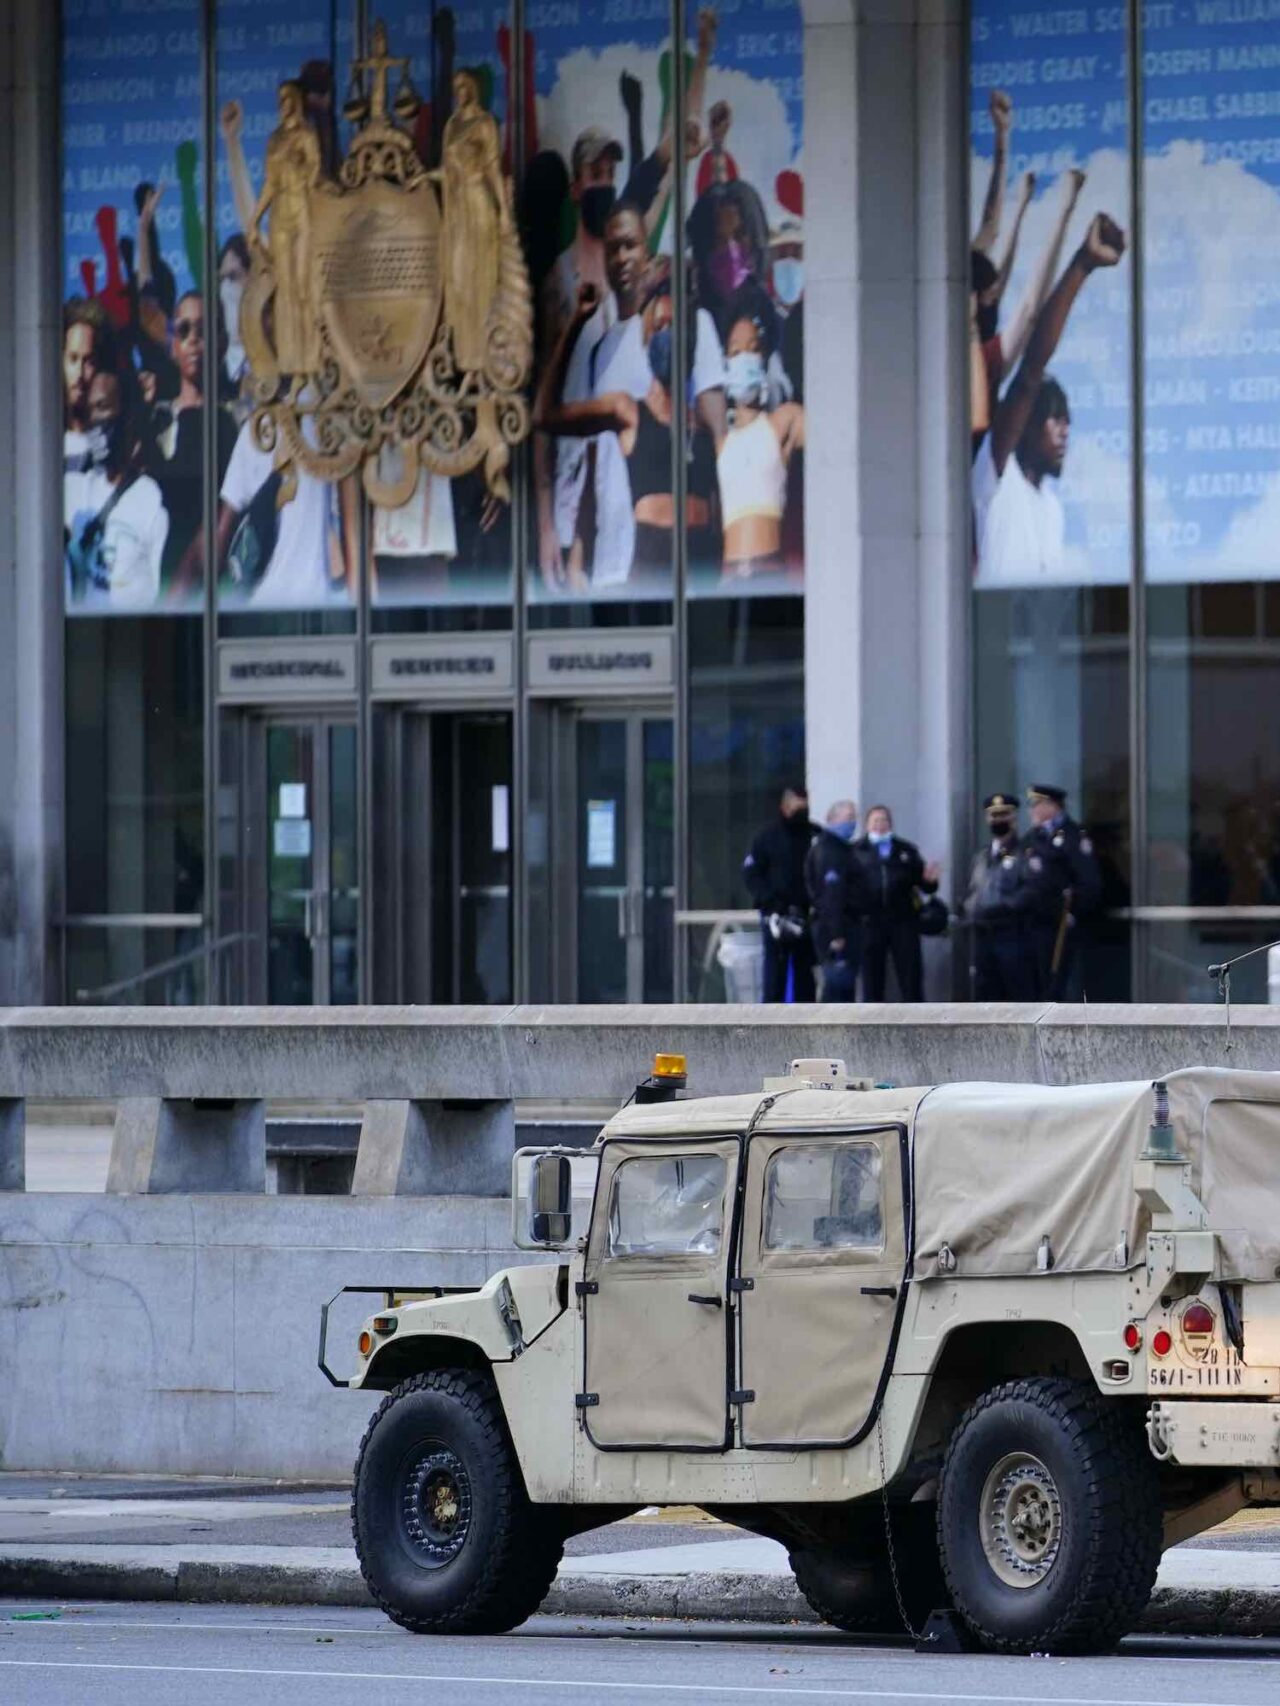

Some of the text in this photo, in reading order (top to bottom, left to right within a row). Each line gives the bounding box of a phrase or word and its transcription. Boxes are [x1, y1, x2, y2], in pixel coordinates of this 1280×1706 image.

[1009, 10, 1088, 37] WALTER
[1041, 54, 1099, 83] GRAY
[80, 163, 143, 191] BLAND
[1184, 425, 1232, 451] MYA
